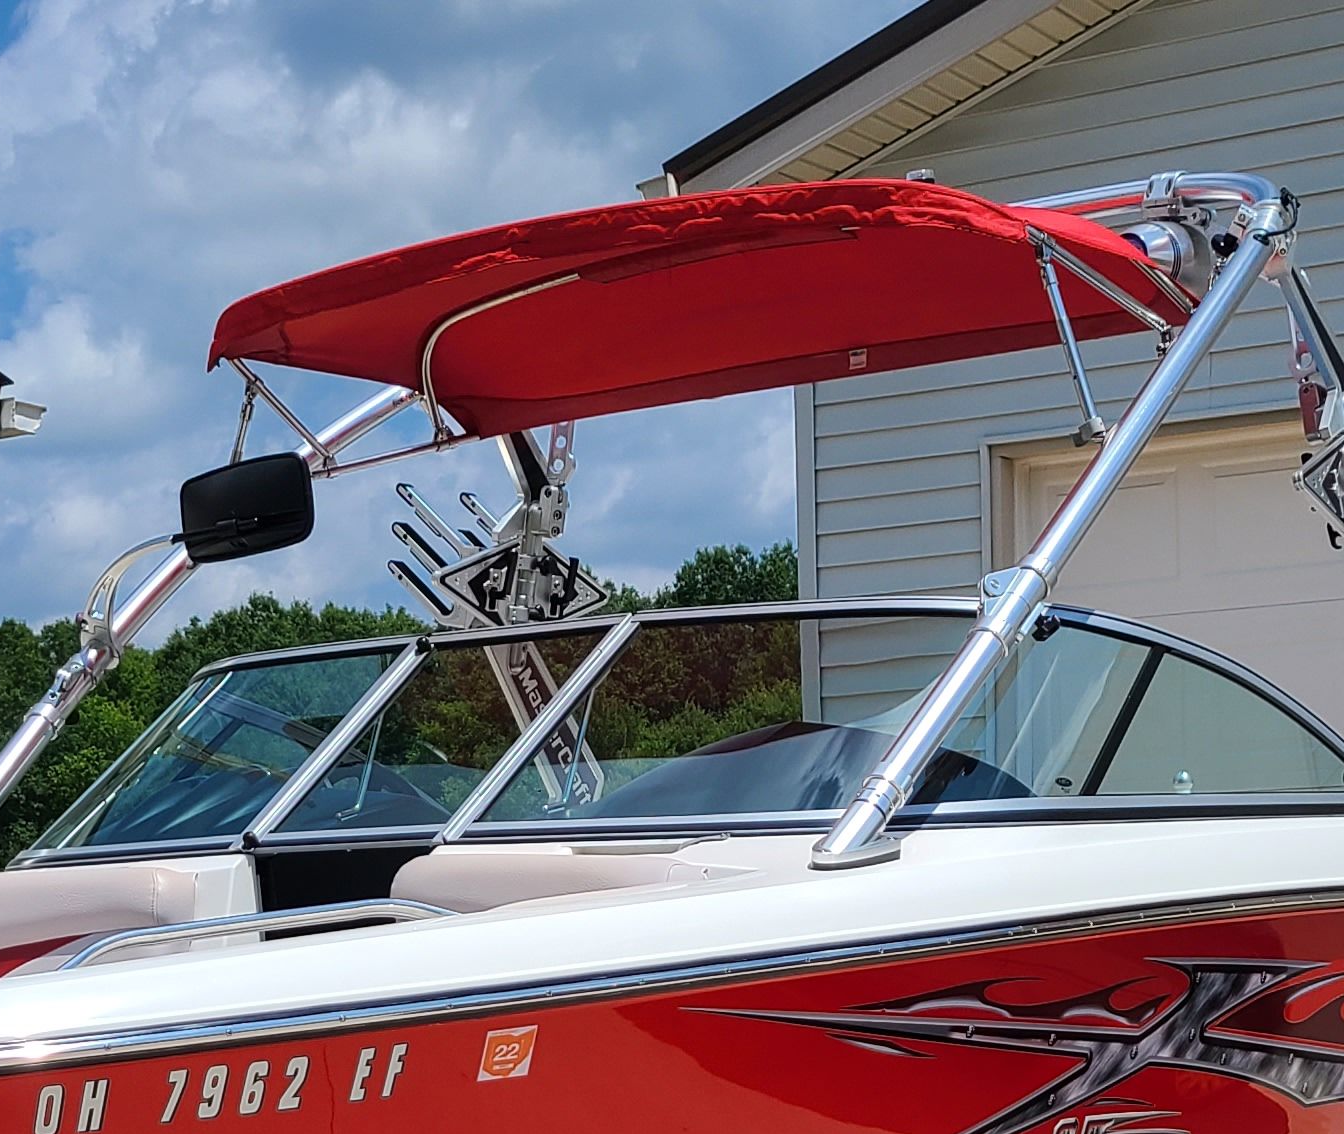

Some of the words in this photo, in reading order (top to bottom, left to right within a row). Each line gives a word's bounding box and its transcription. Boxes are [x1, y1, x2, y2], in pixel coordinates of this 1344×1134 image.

[493, 1042, 520, 1062] 22
[159, 1055, 310, 1124] 7962
[349, 1042, 409, 1102] EF
